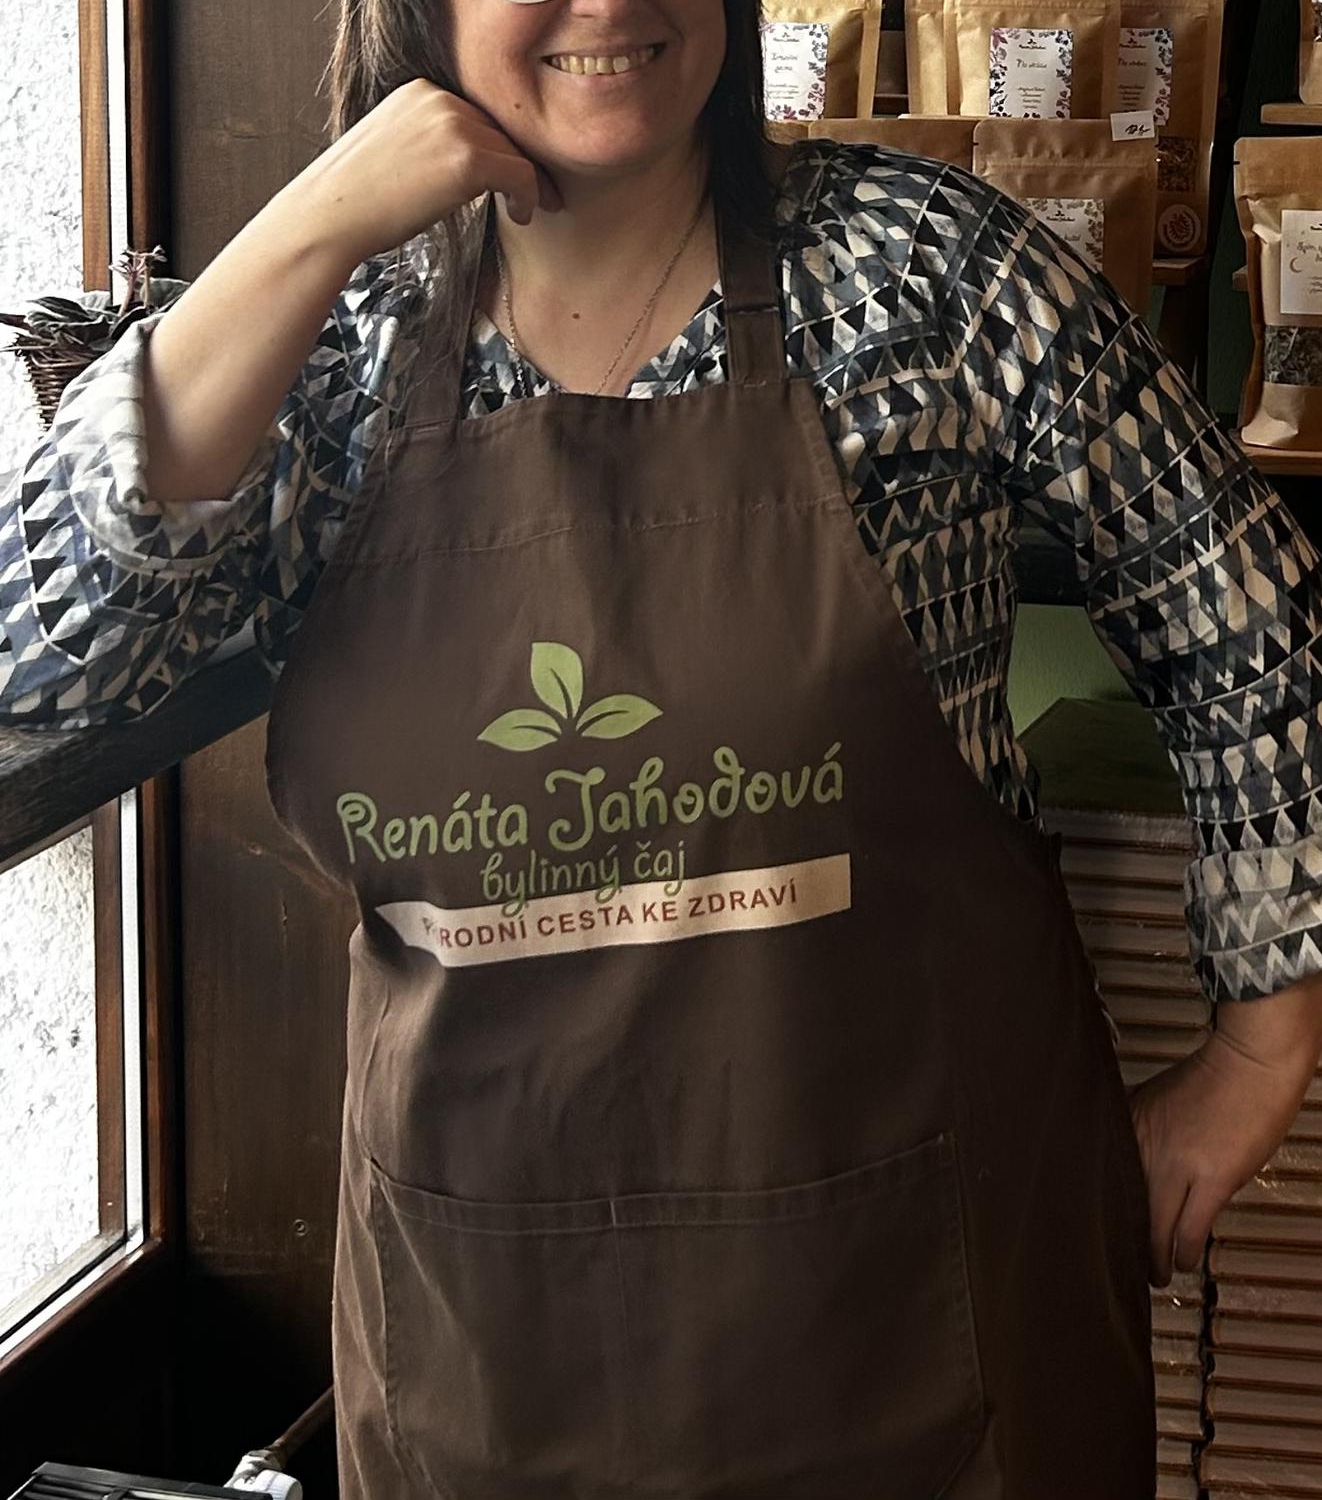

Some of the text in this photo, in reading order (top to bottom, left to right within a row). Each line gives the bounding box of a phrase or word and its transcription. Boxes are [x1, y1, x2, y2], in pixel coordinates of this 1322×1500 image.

[337, 741, 844, 864] Renáta Jahodová
[479, 841, 688, 916] bylinný čaj
[537, 901, 633, 938] CESTA
[642, 900, 679, 924] KE
[688, 877, 799, 918] ZDRAVÍ
